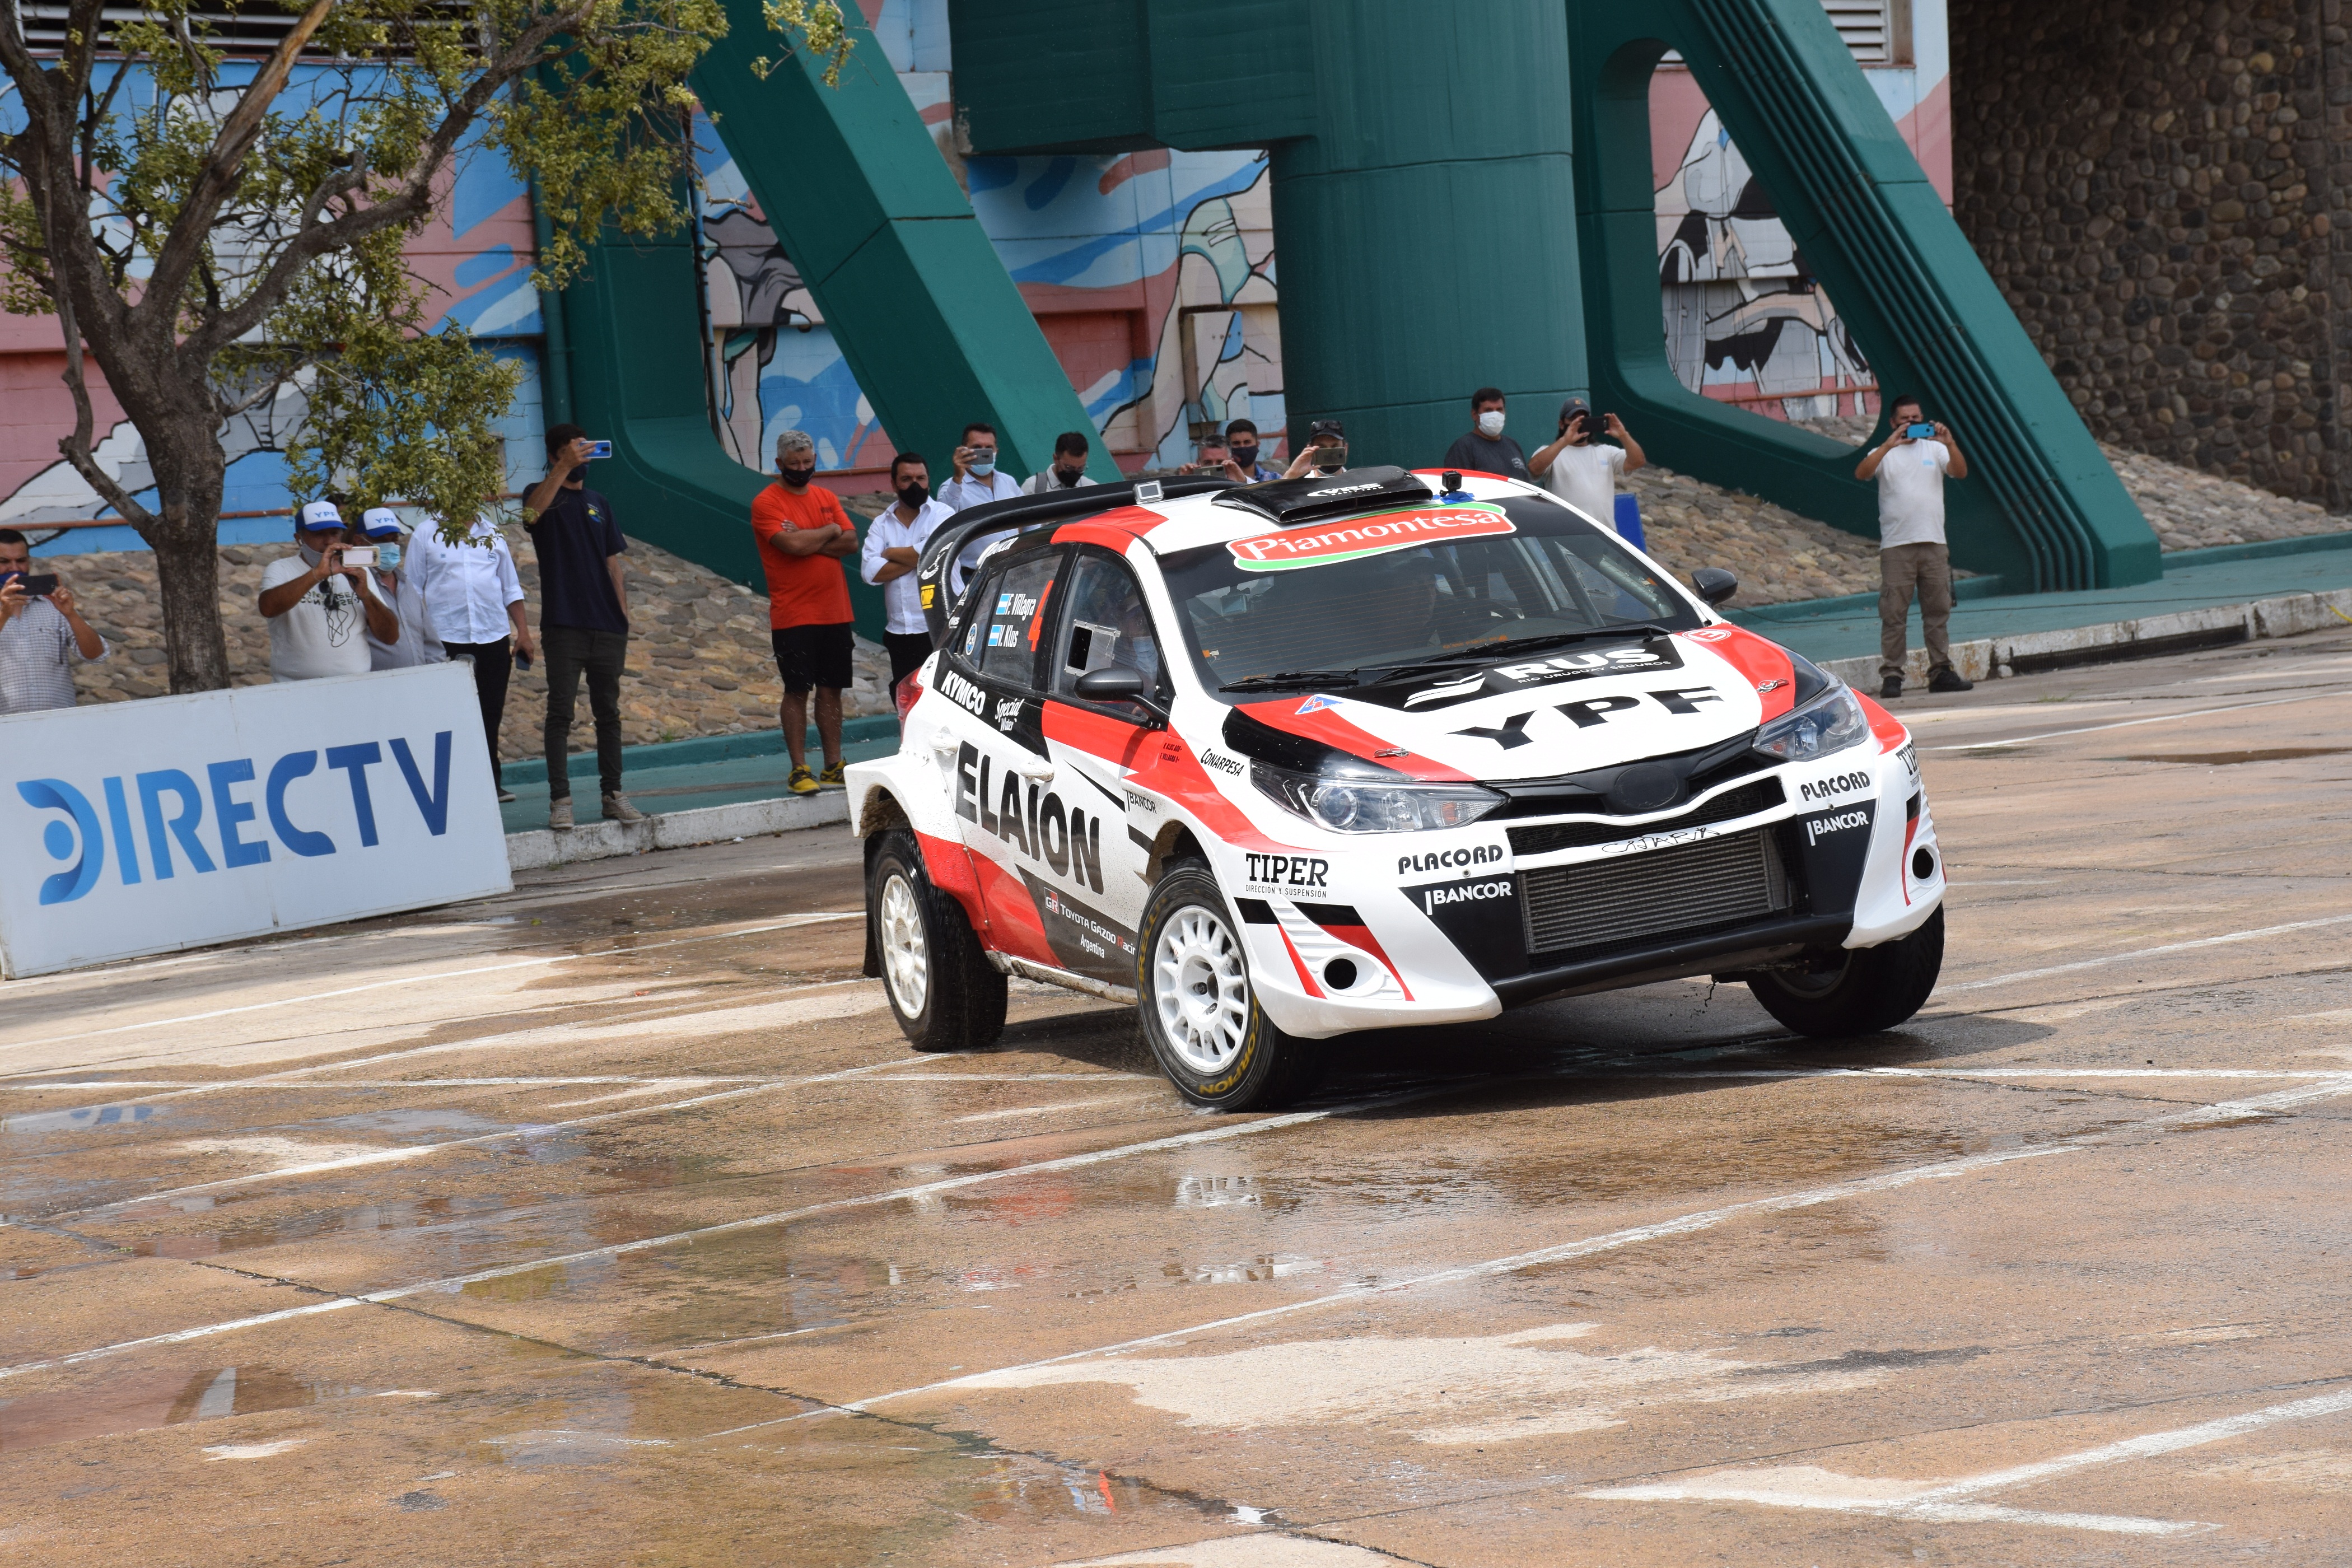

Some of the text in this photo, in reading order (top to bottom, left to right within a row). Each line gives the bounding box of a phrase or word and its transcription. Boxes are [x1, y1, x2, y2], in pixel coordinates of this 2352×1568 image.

[1236, 510, 1500, 561] Piamontesa
[1011, 593, 1037, 621] Villagra
[1028, 580, 1054, 652] 4
[1003, 624, 1019, 647] Klus
[1493, 648, 1660, 679] RUS
[1543, 666, 1605, 680] URUGUAY
[1609, 661, 1672, 670] SEGUROS
[940, 670, 986, 715] KYMCO
[995, 698, 1025, 723] Special
[1445, 686, 1725, 750] YPF
[1200, 748, 1245, 777] CONARPESA
[1800, 771, 1871, 801] PLACORD
[1129, 790, 1157, 814] BANCOR
[16, 730, 452, 906] DIRECTV
[955, 740, 1104, 895] ELAION
[1814, 810, 1869, 836] BANCOR
[1245, 852, 1329, 888] TIPER
[1398, 844, 1504, 875] PLACORD
[1046, 896, 1058, 913] GR
[1245, 884, 1276, 894] DIRECCIÓN
[1285, 887, 1327, 898] SUSPENSIÓN
[1433, 882, 1512, 906] BANCOR
[1060, 903, 1090, 930] TOYOTA
[1090, 920, 1117, 945] GAZOO
[1080, 934, 1105, 959] Argentina
